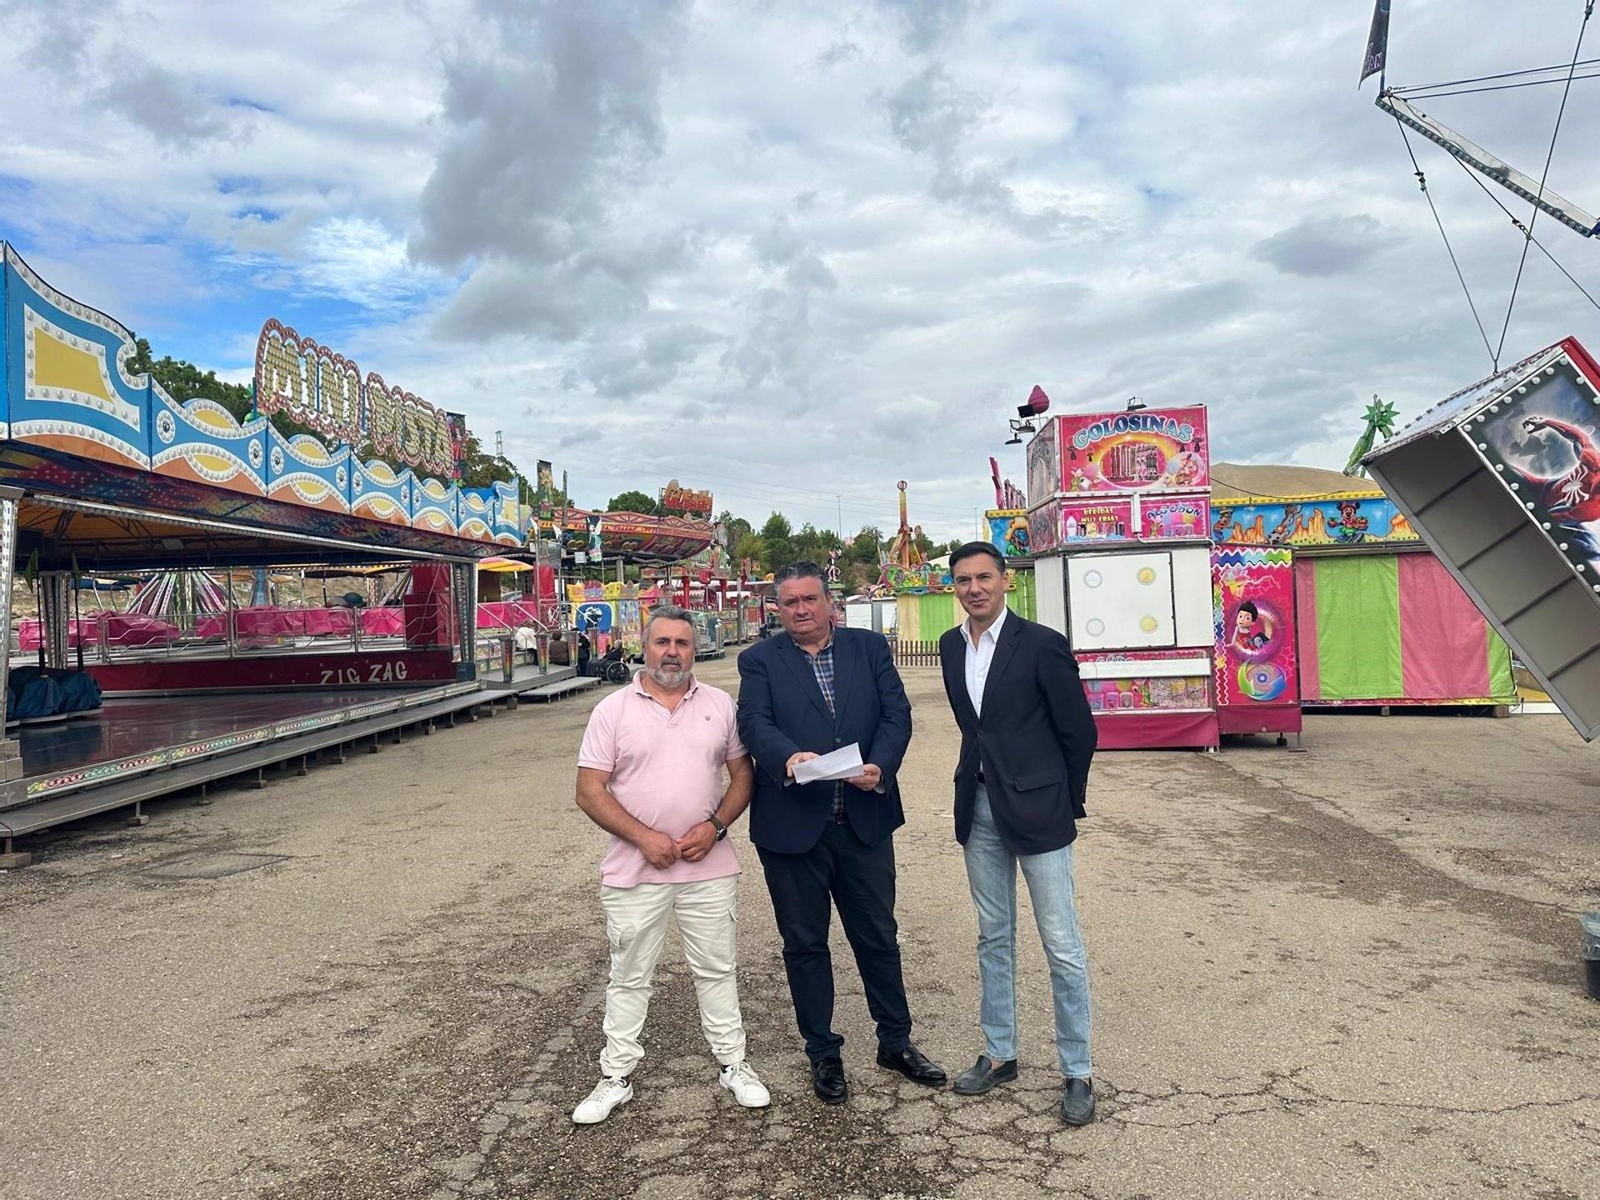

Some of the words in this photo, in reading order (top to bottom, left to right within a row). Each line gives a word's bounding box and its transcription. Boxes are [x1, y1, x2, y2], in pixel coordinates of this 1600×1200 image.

[261, 328, 361, 434] MINI
[368, 380, 453, 472] PISTA
[1073, 413, 1194, 449] GOLOSINAS
[320, 668, 360, 685] ZIG
[368, 661, 407, 682] ZAG
